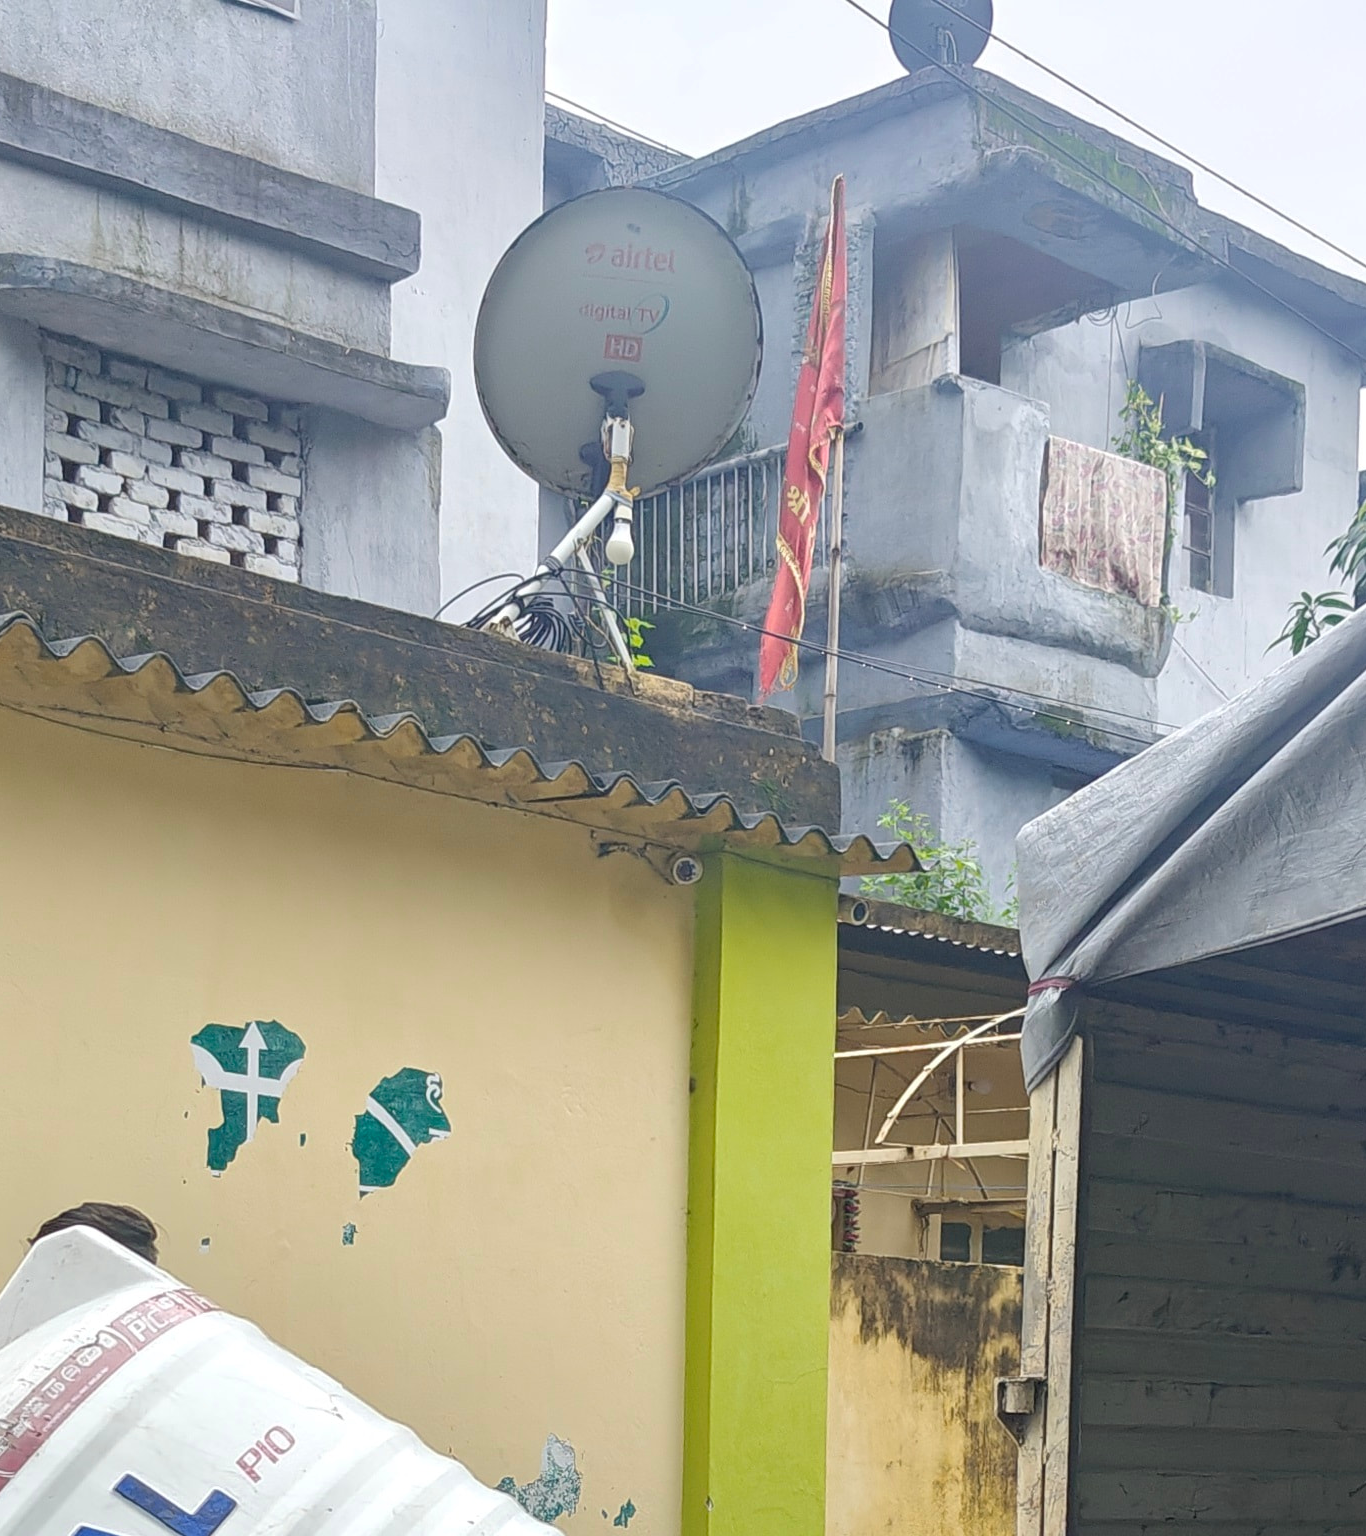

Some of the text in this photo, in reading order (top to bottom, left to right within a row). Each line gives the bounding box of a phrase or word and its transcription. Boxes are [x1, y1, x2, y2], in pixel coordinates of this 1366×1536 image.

[611, 242, 676, 274] airtel
[578, 303, 660, 323] digital TV
[609, 337, 639, 358] HD
[235, 1424, 297, 1484] PIO
